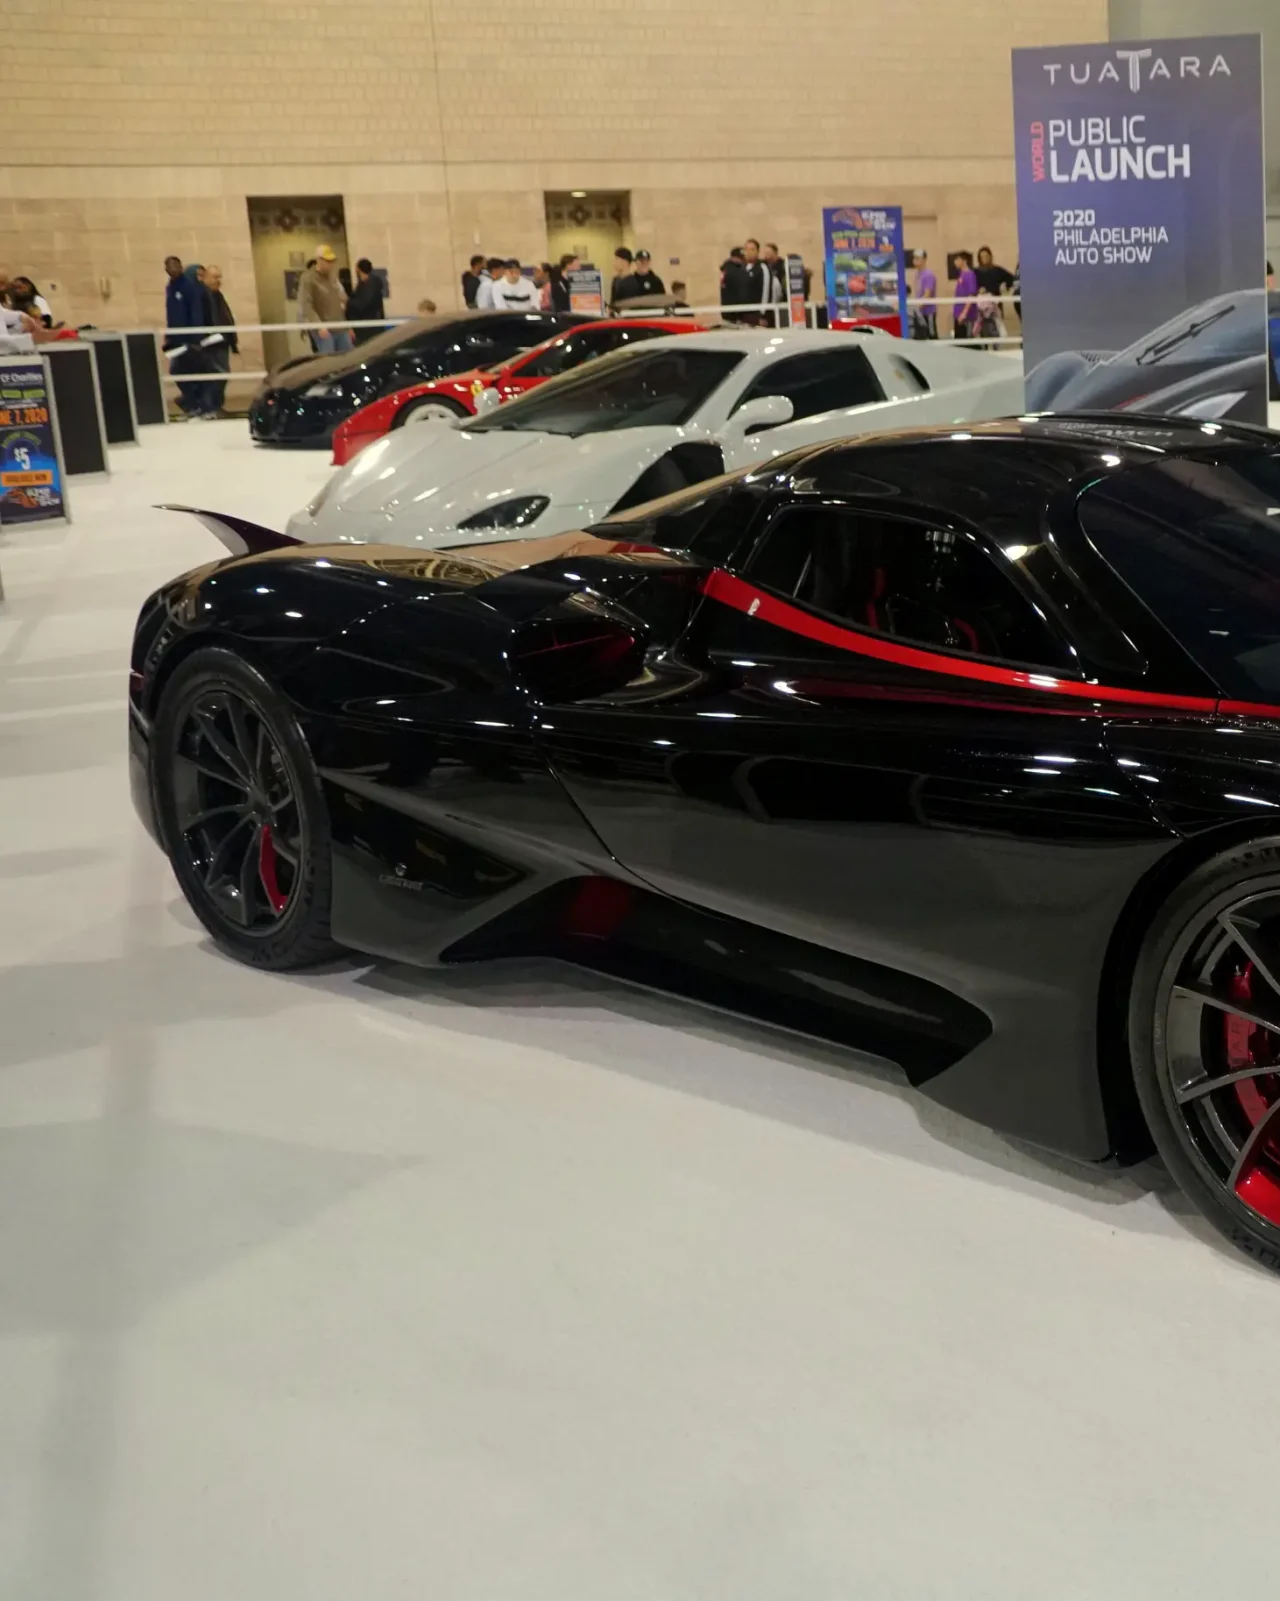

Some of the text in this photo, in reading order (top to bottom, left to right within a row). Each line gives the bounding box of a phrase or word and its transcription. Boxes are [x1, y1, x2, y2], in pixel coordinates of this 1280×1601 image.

[1043, 48, 1231, 93] TUATARA
[1049, 115, 1146, 146] PUBLIC
[1031, 121, 1045, 182] WORLD
[1051, 144, 1191, 183] LAUNCH
[1053, 209, 1095, 226] 2020
[1054, 226, 1168, 246] PHILADELPHIA
[1055, 246, 1153, 266] AUTO SHOW
[14, 447, 31, 470] $5
